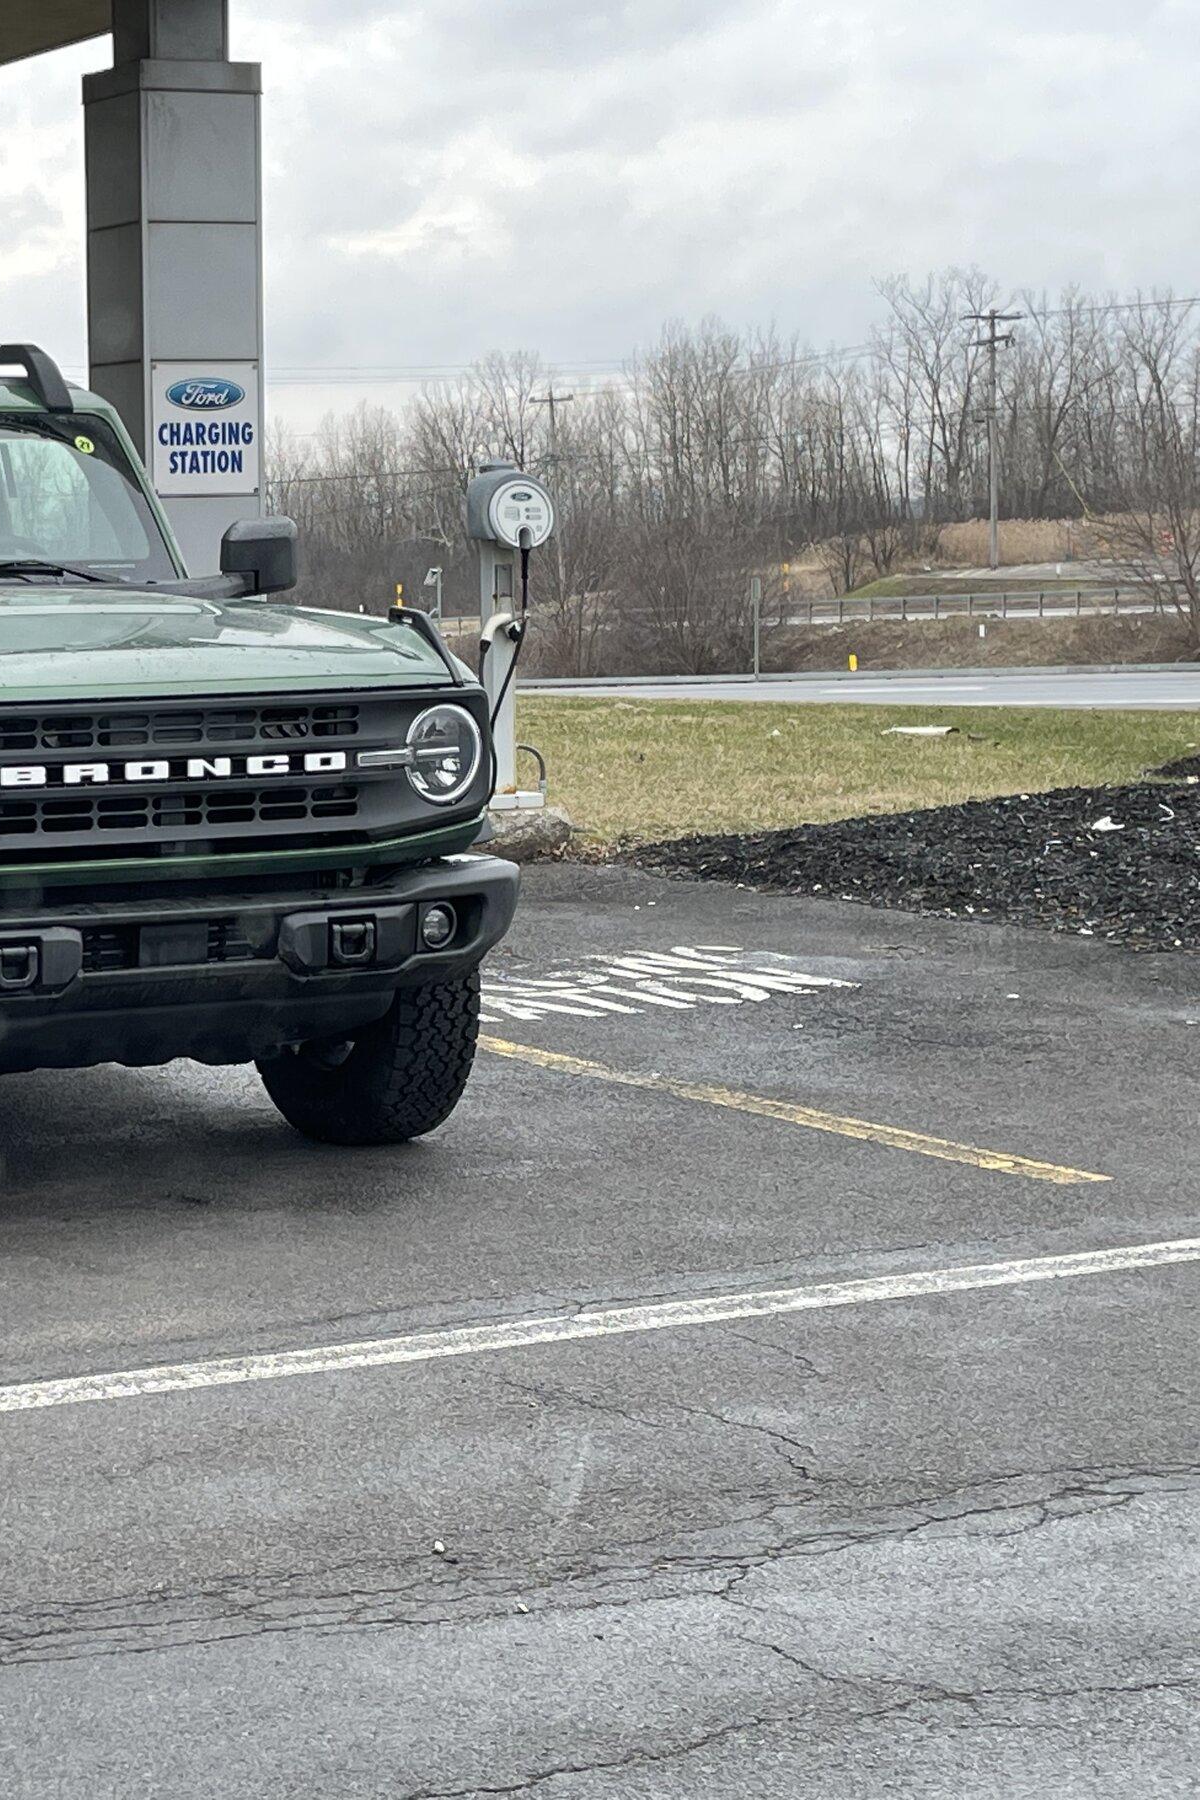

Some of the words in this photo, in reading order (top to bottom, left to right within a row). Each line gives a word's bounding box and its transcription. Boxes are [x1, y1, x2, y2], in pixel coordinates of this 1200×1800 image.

[181, 383, 228, 405] Ford
[158, 422, 253, 446] CHARGING
[169, 450, 242, 474] STATION
[0, 752, 346, 787] BRONCO
